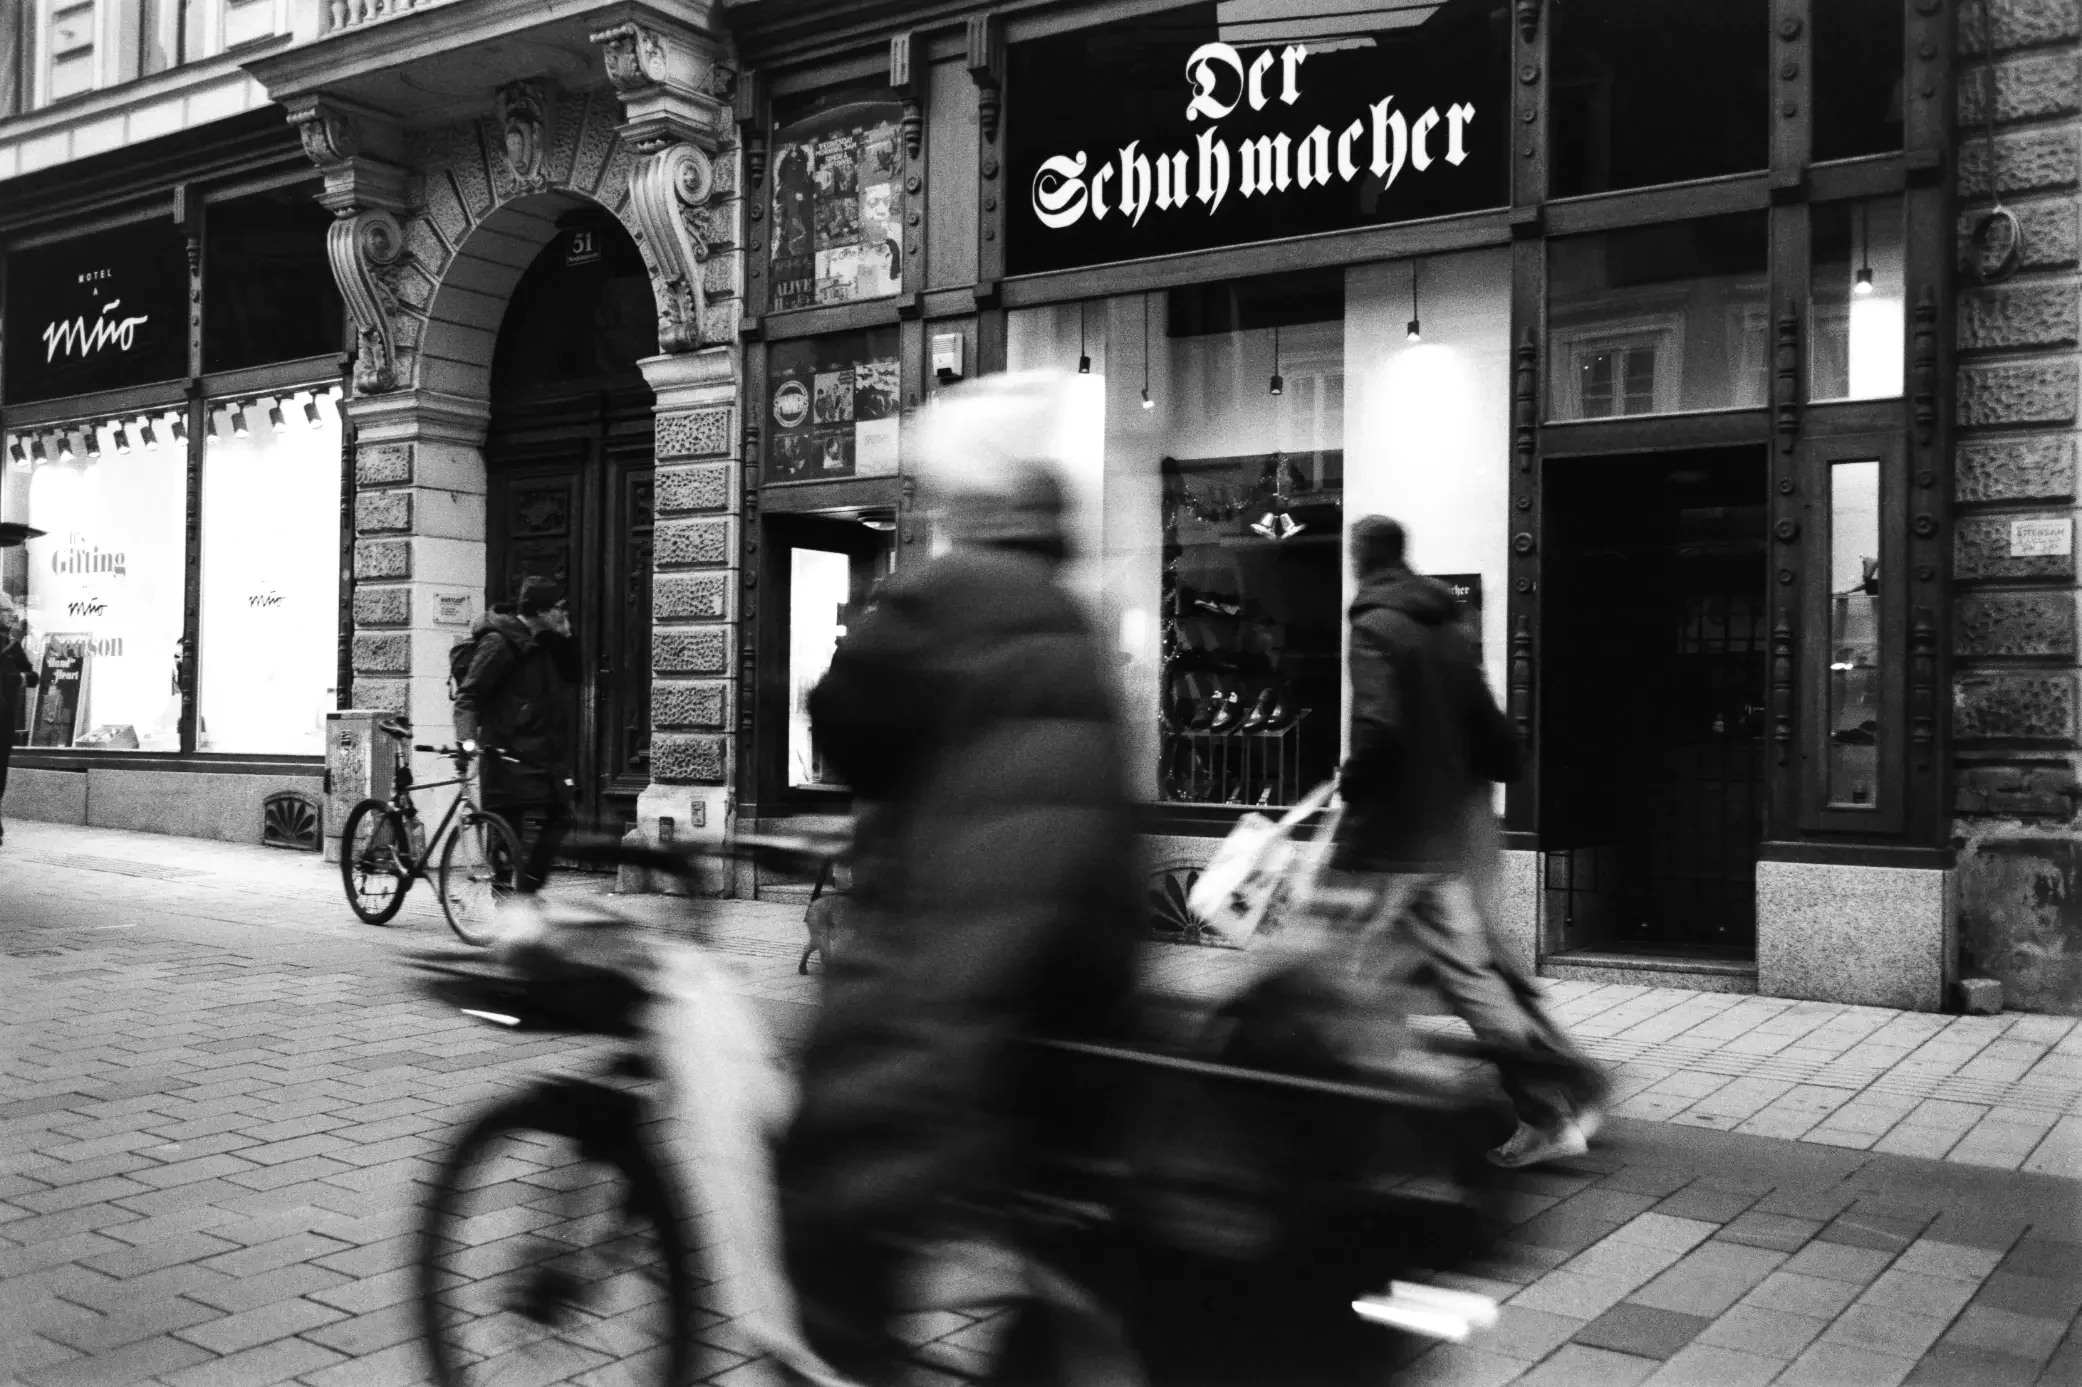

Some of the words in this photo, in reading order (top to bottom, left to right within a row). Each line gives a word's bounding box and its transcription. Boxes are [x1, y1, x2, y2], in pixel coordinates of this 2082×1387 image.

[1185, 41, 1308, 121] Der
[1032, 94, 1476, 229] Schuhmacher
[78, 269, 112, 284] MOTEL
[92, 287, 98, 296] A
[51, 545, 126, 578] Gifting
